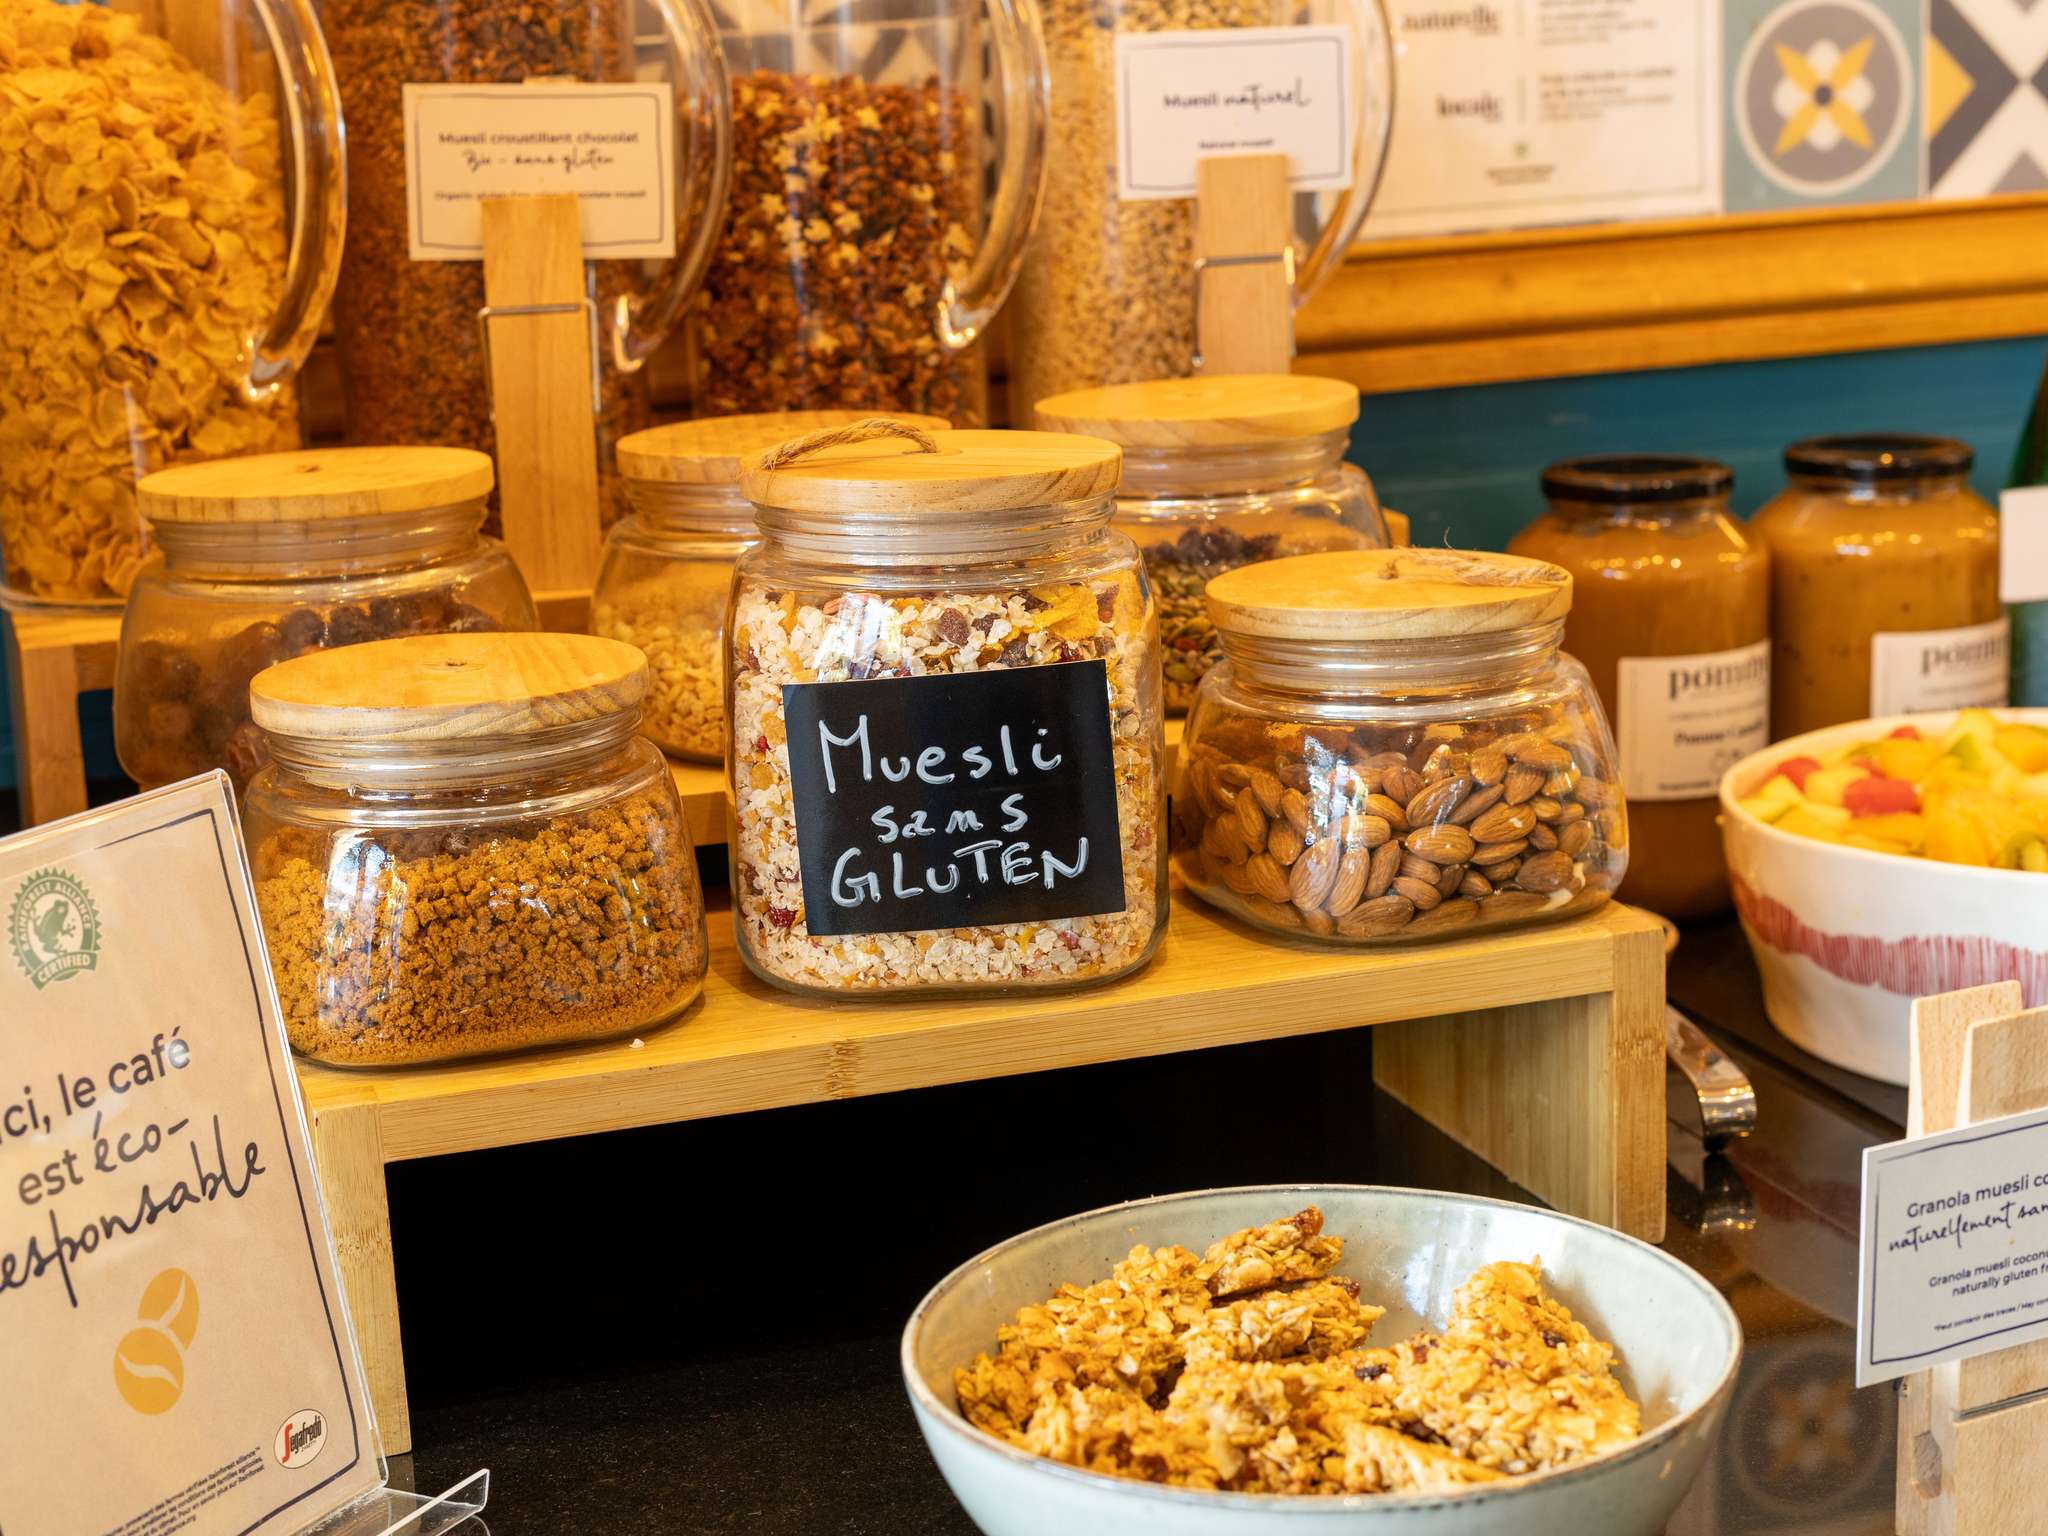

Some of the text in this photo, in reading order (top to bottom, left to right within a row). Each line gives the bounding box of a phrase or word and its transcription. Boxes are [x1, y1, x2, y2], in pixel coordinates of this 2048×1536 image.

[1164, 77, 1311, 112] Muesli naturel
[438, 131, 639, 145] Muesli croustillant chocolat
[819, 715, 1062, 794] Muesli
[830, 837, 1090, 908] GLUTEN
[19, 881, 92, 951] RAINFOREST ALLIANCE
[37, 953, 91, 982] CERTIFIED
[0, 1026, 191, 1145] ci, le café
[18, 1110, 189, 1206] est éco-
[0, 1114, 267, 1309] esponsable
[1907, 1190, 1971, 1219] Granola
[1975, 1174, 2030, 1202] muesli
[1888, 1201, 2017, 1253] naturellement
[1928, 1266, 1972, 1288] Granola
[1974, 1257, 2011, 1276] muesli
[1952, 1275, 2000, 1298] naturally
[2003, 1267, 2038, 1286] gluten
[282, 1415, 322, 1463] Segafredo
